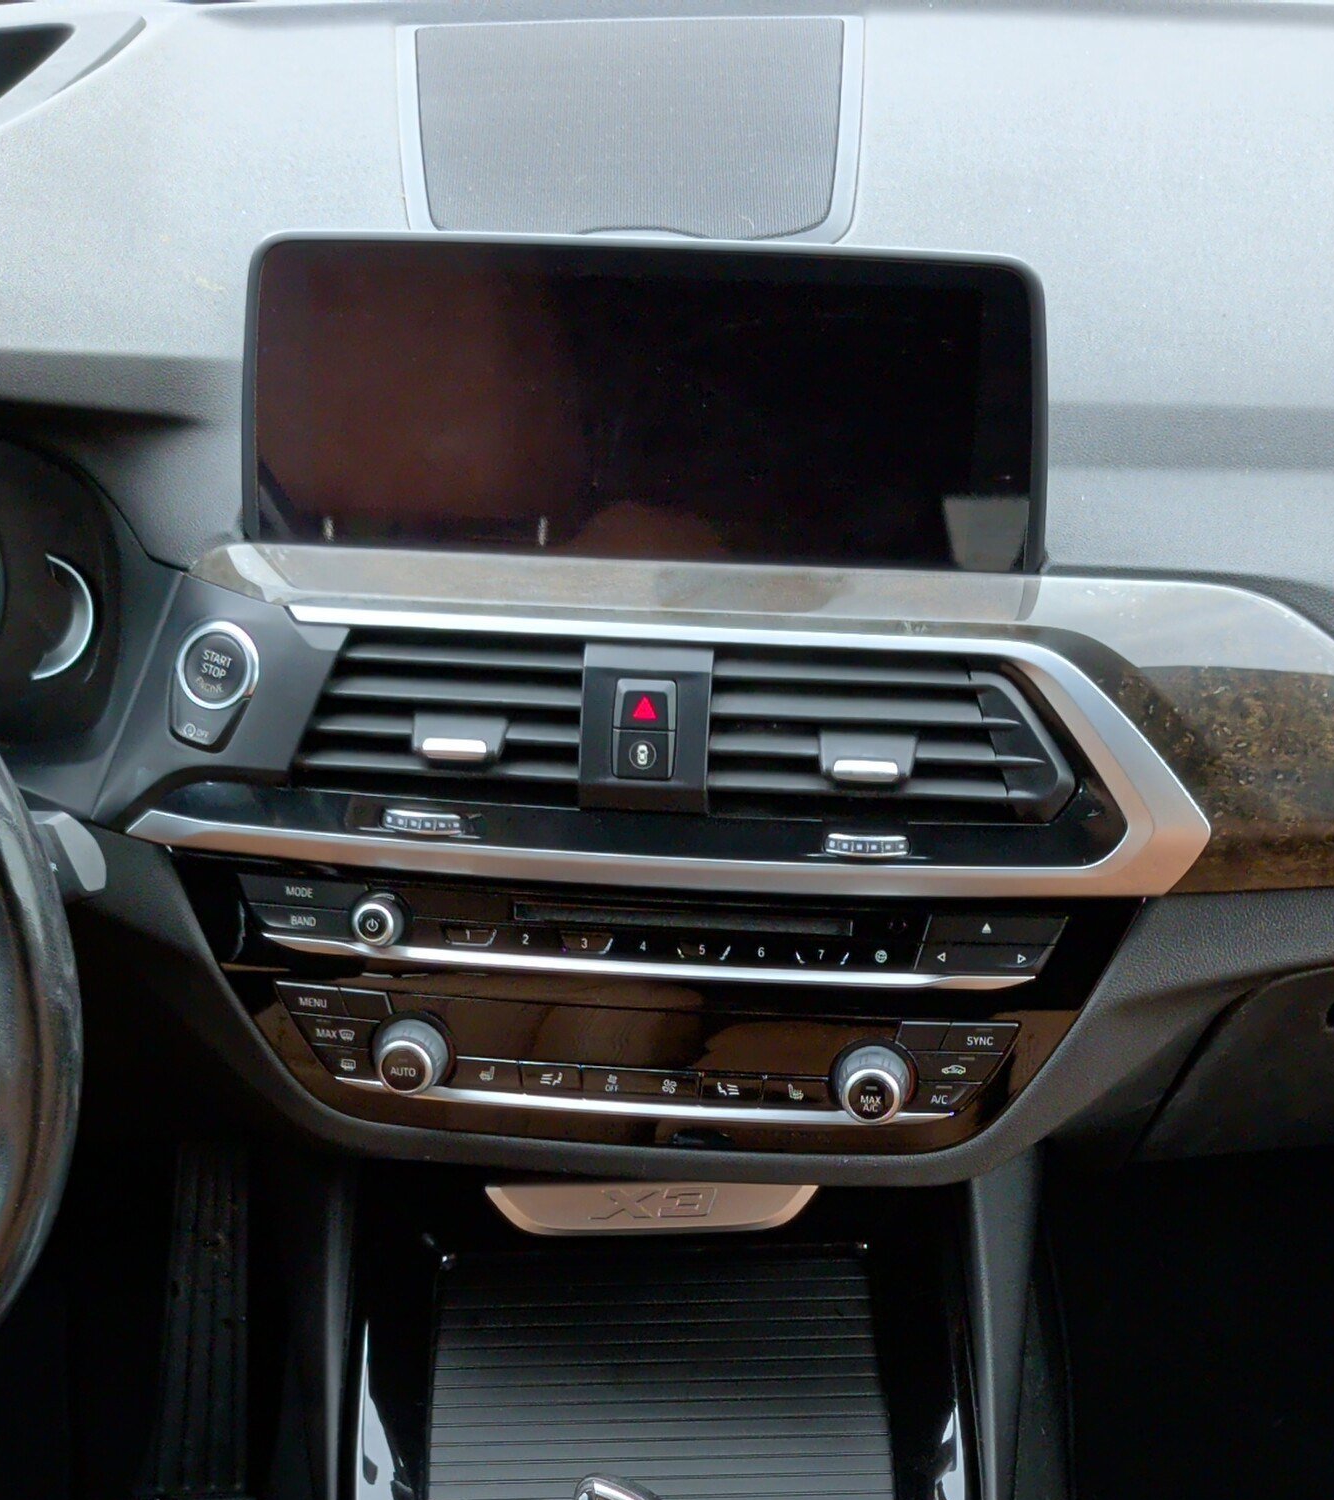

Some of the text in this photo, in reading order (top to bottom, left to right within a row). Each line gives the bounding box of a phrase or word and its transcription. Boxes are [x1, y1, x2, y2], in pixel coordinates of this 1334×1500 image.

[202, 649, 233, 668] START
[201, 662, 227, 679] STOP
[285, 885, 314, 899] MODE
[290, 915, 317, 927] BAND
[522, 934, 529, 945] 2
[581, 938, 588, 949] 3
[640, 941, 647, 951] 4
[699, 944, 706, 956] 5
[757, 946, 765, 958] 6
[818, 949, 825, 960] 7
[298, 997, 328, 1009] MENU
[316, 1028, 337, 1039] MAX
[966, 1036, 994, 1046] SYNC
[390, 1066, 417, 1078] AUTO
[605, 1084, 619, 1092] OFF
[860, 1095, 882, 1104] MAX
[930, 1095, 948, 1105] A/C
[862, 1103, 878, 1113] A/C
[587, 1187, 717, 1220] X3
